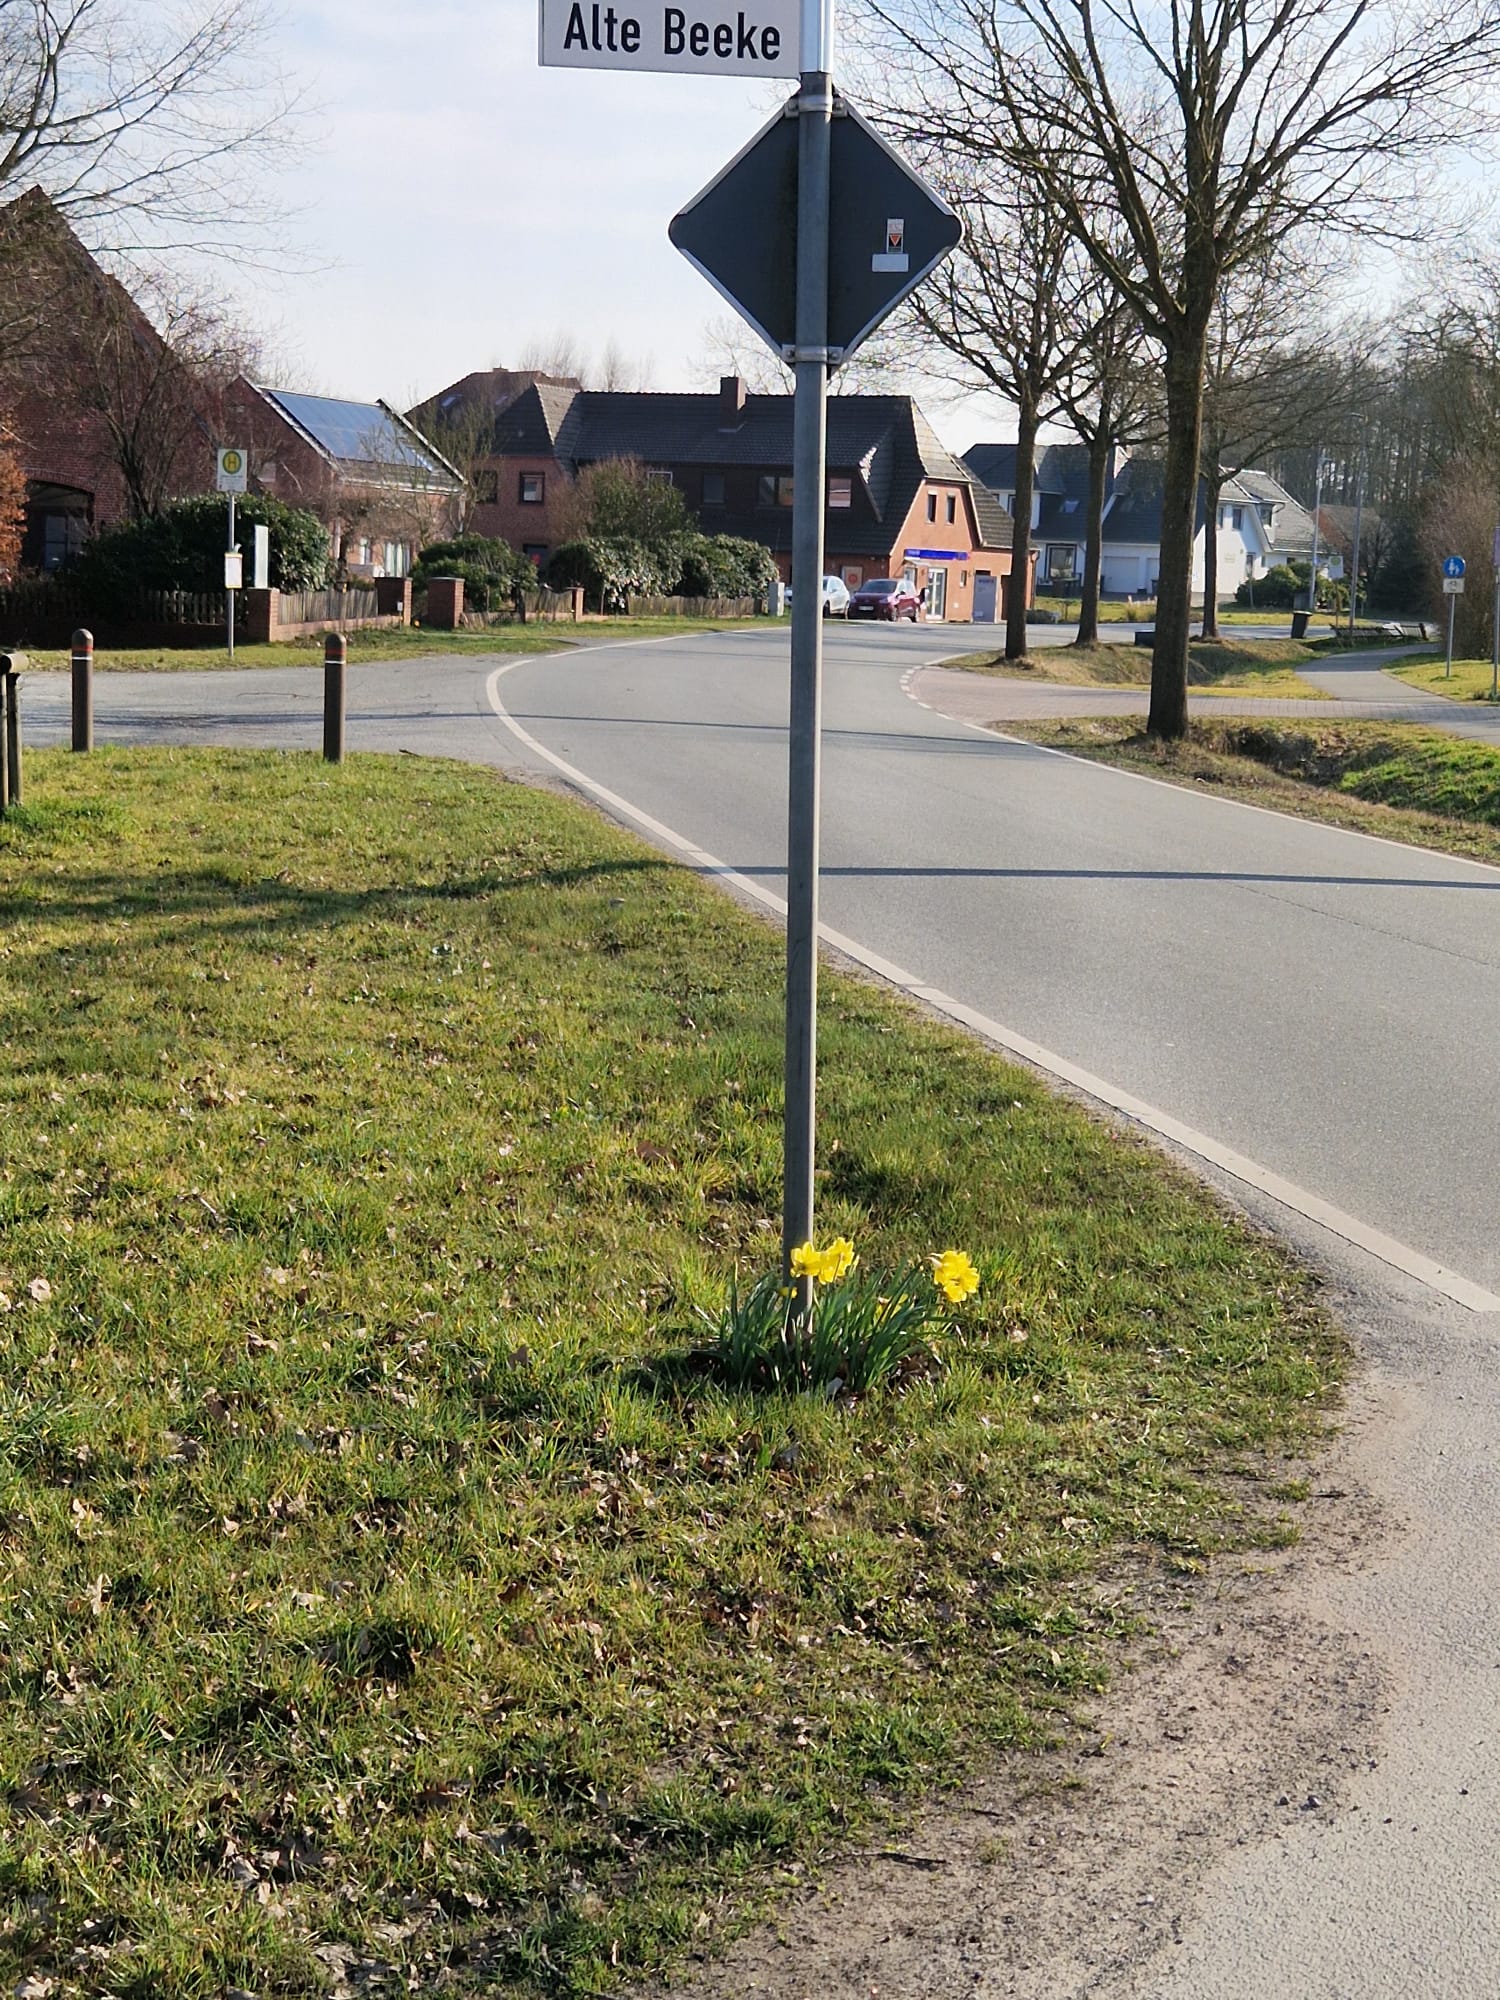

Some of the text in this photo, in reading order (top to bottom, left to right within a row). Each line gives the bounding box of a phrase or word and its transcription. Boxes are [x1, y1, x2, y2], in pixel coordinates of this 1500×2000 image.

[563, 2, 780, 60] Alte Beeke
[228, 455, 237, 469] H
